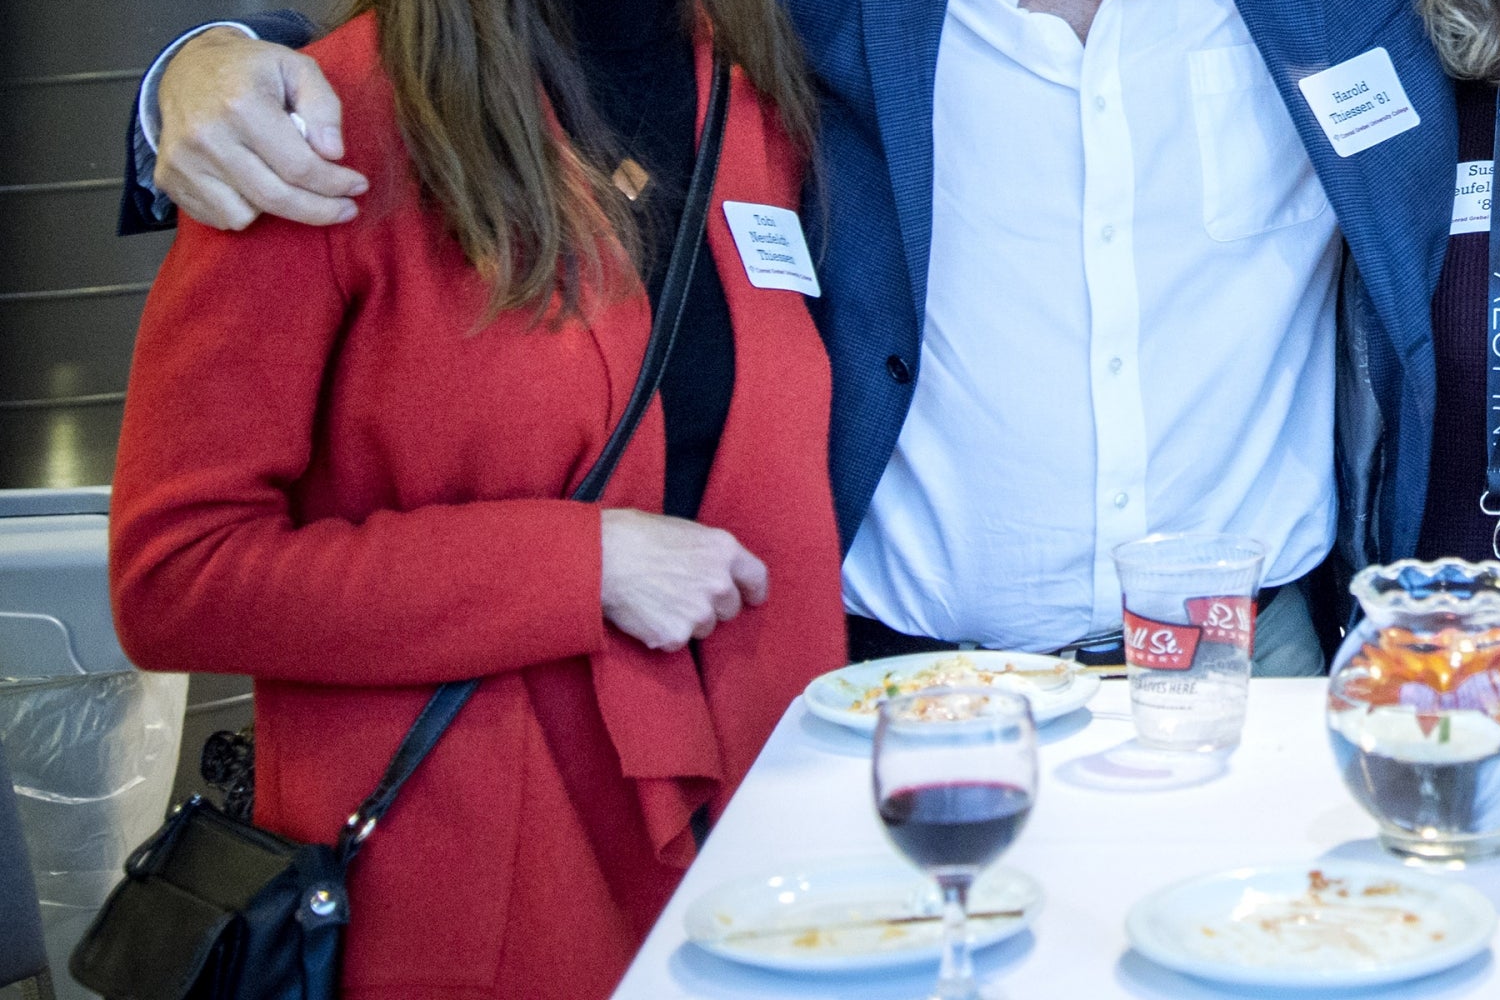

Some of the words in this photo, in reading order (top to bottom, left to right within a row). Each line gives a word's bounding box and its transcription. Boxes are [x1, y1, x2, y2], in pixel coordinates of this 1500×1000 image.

[1332, 80, 1370, 104] Harold
[1468, 164, 1495, 177] Sus
[1454, 181, 1491, 196] eufel
[1477, 199, 1491, 210] '8
[1149, 629, 1184, 656] St.
